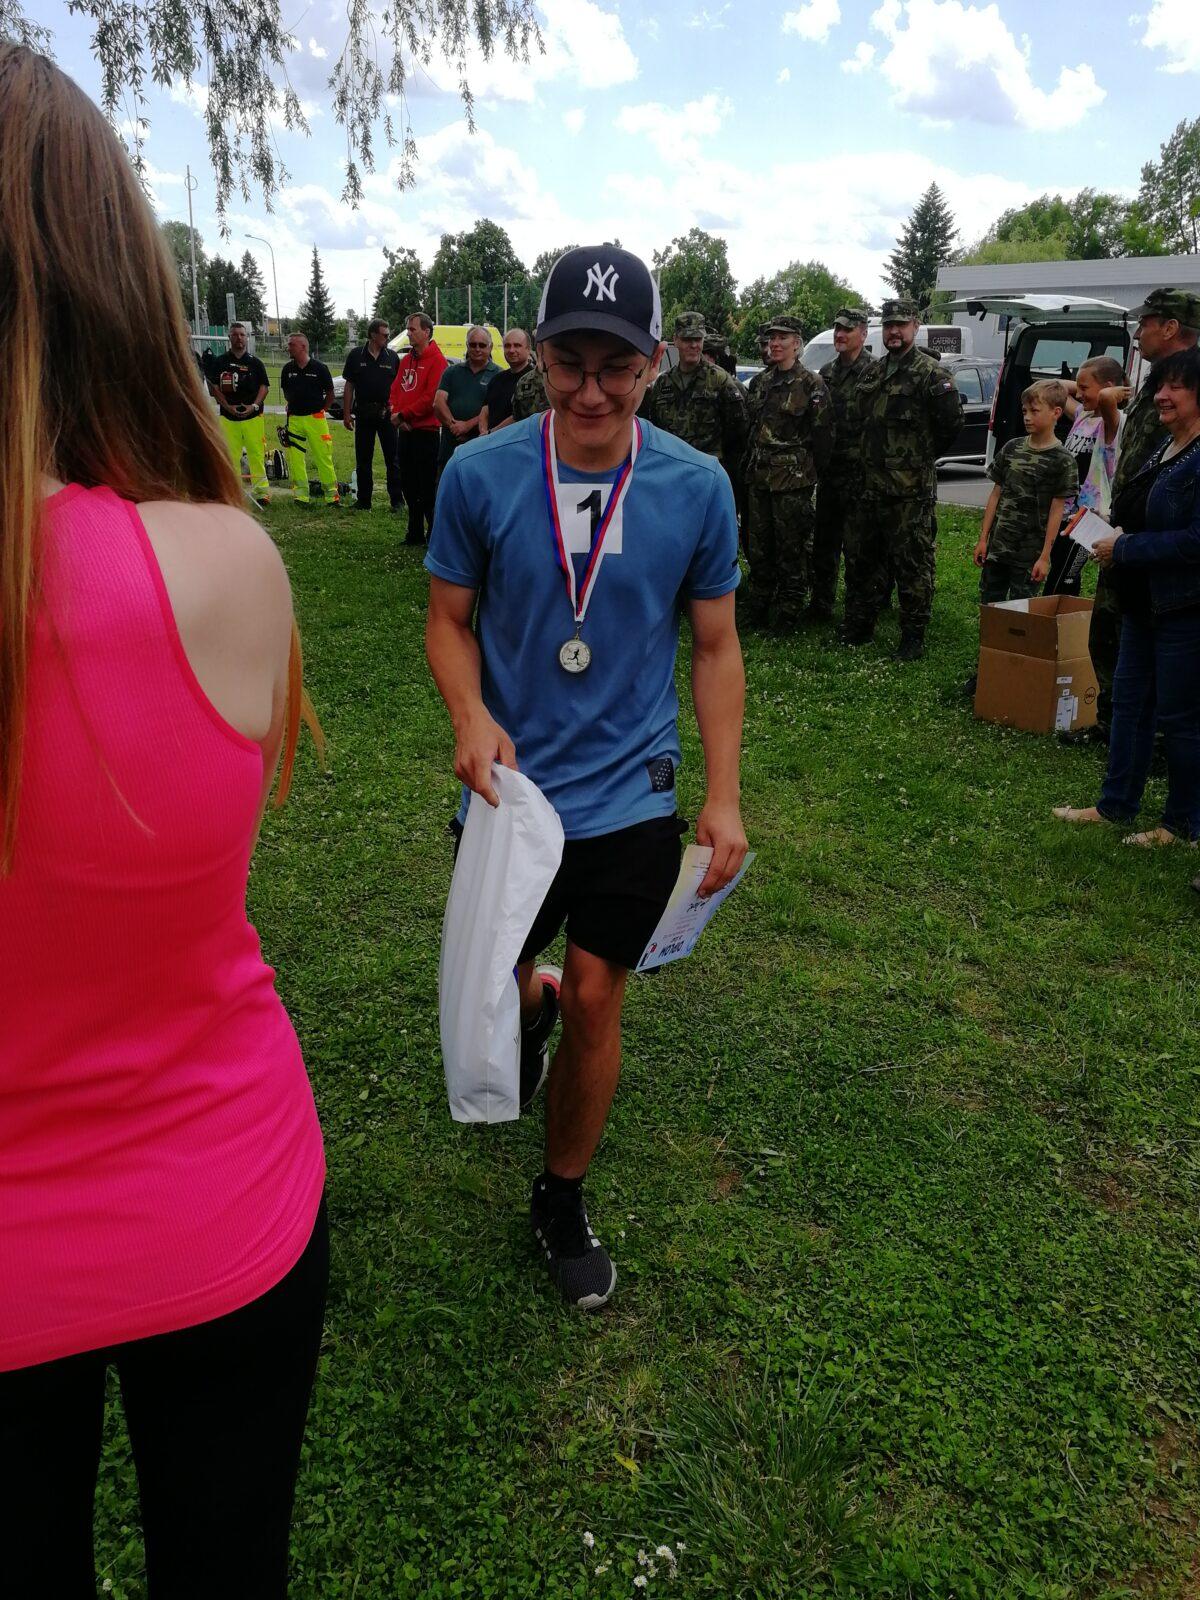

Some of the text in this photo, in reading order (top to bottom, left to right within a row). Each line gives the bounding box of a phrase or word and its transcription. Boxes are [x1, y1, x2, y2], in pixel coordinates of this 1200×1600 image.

[583, 262, 619, 302] NY
[932, 336, 957, 345] CATERING
[577, 490, 602, 549] 1
